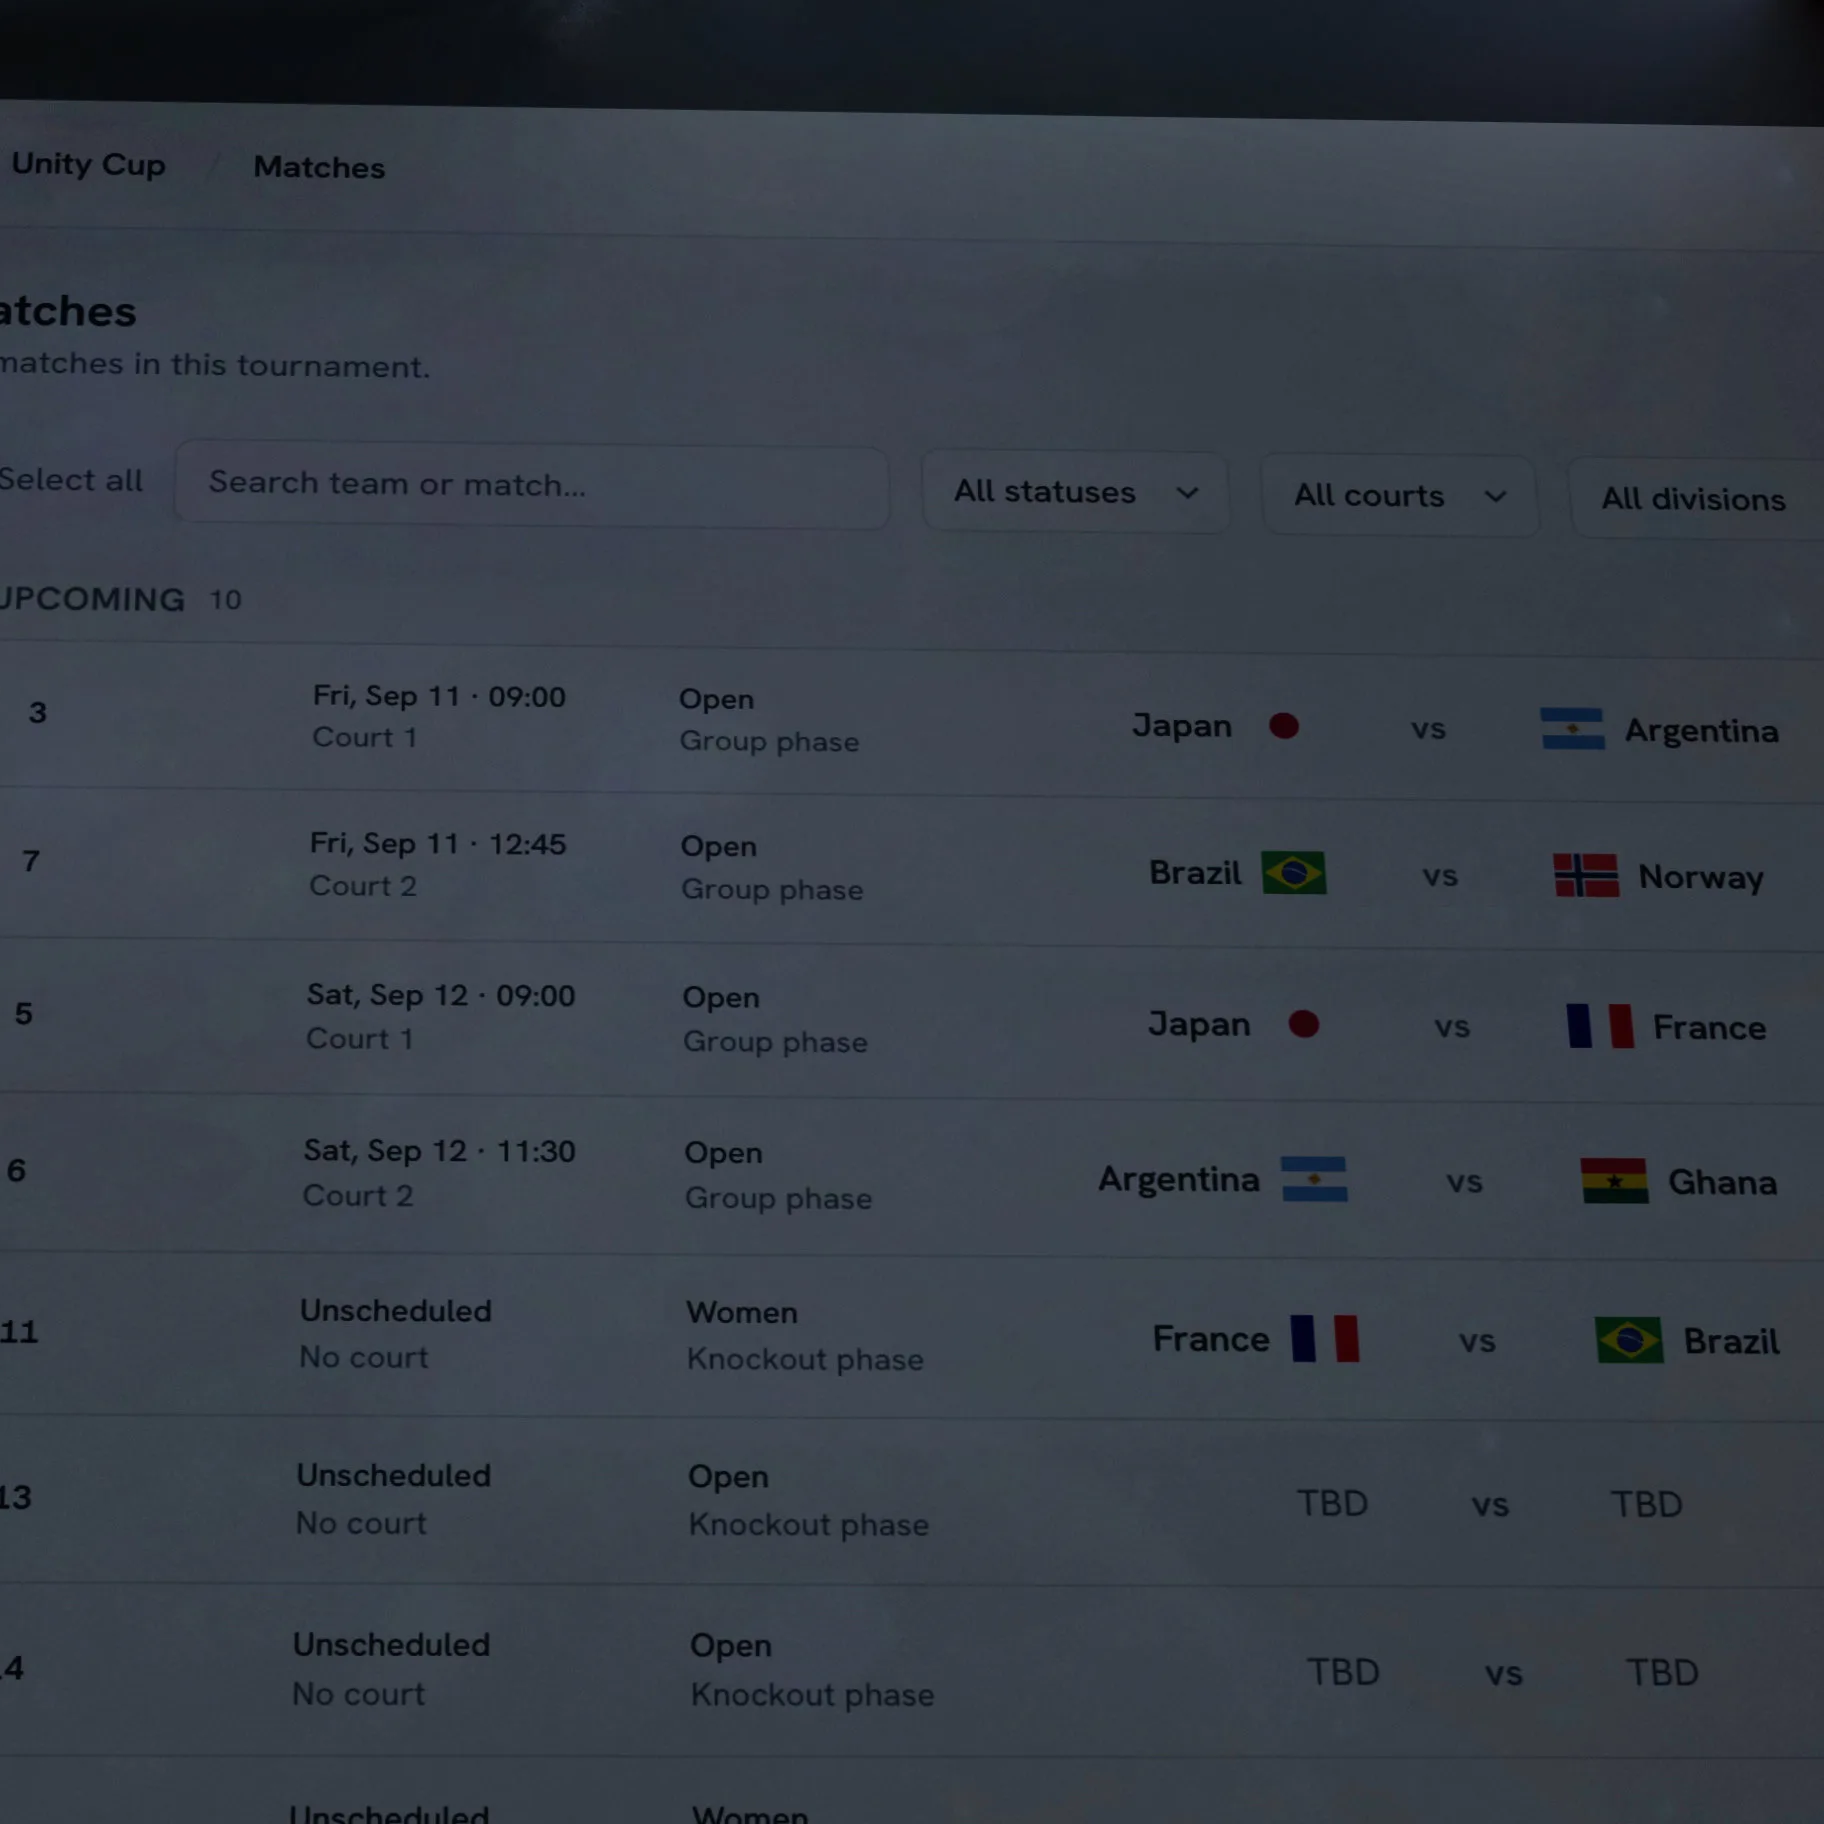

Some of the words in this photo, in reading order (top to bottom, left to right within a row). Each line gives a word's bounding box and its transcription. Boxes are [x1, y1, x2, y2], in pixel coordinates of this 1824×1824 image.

[12, 151, 93, 181] Unity
[102, 152, 166, 182] Cup
[254, 154, 386, 180] Matches
[135, 351, 161, 375] in
[170, 352, 227, 377] this
[237, 354, 430, 379] tournament.
[105, 468, 144, 493] all
[208, 468, 319, 494] Search
[328, 472, 409, 496] team
[419, 477, 454, 496] or
[464, 473, 586, 497] match...
[954, 478, 996, 503] All
[1005, 480, 1137, 505] statuses
[1294, 482, 1336, 507] All
[1344, 485, 1445, 508] courts
[1601, 485, 1643, 511] All
[1651, 486, 1787, 512] divisions
[211, 589, 242, 610] 10
[314, 683, 357, 710] Fri,
[365, 684, 418, 712] Sep
[429, 685, 458, 707] 11
[488, 685, 567, 708] 09:00
[679, 687, 755, 715] Open
[28, 701, 47, 724] 3
[312, 725, 394, 748] Court
[404, 726, 416, 748] 1
[679, 729, 768, 757] Group
[776, 731, 860, 758] phase
[1132, 712, 1232, 744] Japan
[1625, 717, 1780, 749] Argentina
[310, 831, 354, 858] Fri,
[363, 831, 416, 860] Sep
[427, 832, 457, 855] 11
[490, 832, 567, 856] 12:45
[680, 834, 757, 863] Open
[22, 849, 41, 873] 7
[309, 873, 392, 897] Court
[400, 874, 417, 897] 2
[681, 877, 771, 906] Group
[779, 878, 864, 906] phase
[1150, 859, 1243, 885] Brazil
[1639, 863, 1764, 897] Norway
[306, 982, 361, 1010] Sat,
[369, 982, 424, 1012] Sep
[435, 983, 469, 1007] 12
[496, 983, 576, 1008] 09:00
[682, 985, 760, 1014] Open
[15, 1001, 33, 1026] 5
[1148, 1009, 1251, 1044] Japan
[1653, 1013, 1767, 1041] France
[306, 1026, 390, 1050] Court
[400, 1027, 412, 1050] 1
[683, 1029, 774, 1059] Group
[783, 1030, 869, 1059] phase
[303, 1138, 359, 1166] Sat,
[367, 1138, 422, 1168] Sep
[433, 1138, 468, 1163] 12
[498, 1139, 576, 1164] 11:30
[684, 1140, 763, 1170] Open
[7, 1158, 26, 1183] 6
[1098, 1164, 1261, 1199] Argentina
[1668, 1168, 1778, 1196] Ghana
[302, 1183, 387, 1208] Court
[396, 1183, 414, 1208] 2
[685, 1185, 777, 1216] Group
[786, 1186, 873, 1216] phase
[300, 1298, 492, 1323] Unscheduled
[685, 1299, 798, 1325] Women
[0, 1319, 39, 1344] 11
[1153, 1324, 1271, 1353] France
[1684, 1326, 1781, 1355] Brazil
[300, 1344, 340, 1369] No
[349, 1346, 429, 1369] court
[688, 1346, 828, 1371] Knockout
[836, 1347, 925, 1377] phase
[297, 1462, 491, 1488] Unscheduled
[688, 1463, 769, 1495] Open
[1296, 1488, 1369, 1517] TBD
[1610, 1489, 1683, 1518] TBD
[296, 1510, 338, 1535] No
[346, 1512, 427, 1536] court
[689, 1511, 831, 1537] Knockout
[841, 1512, 930, 1543] phase
[293, 1631, 490, 1657] Unscheduled
[690, 1631, 772, 1664] Open
[1306, 1656, 1380, 1686] TBD
[1625, 1657, 1699, 1687] TBD
[293, 1680, 335, 1706] No
[344, 1682, 426, 1707] court
[692, 1681, 836, 1707] Knockout
[845, 1682, 935, 1714] phase
